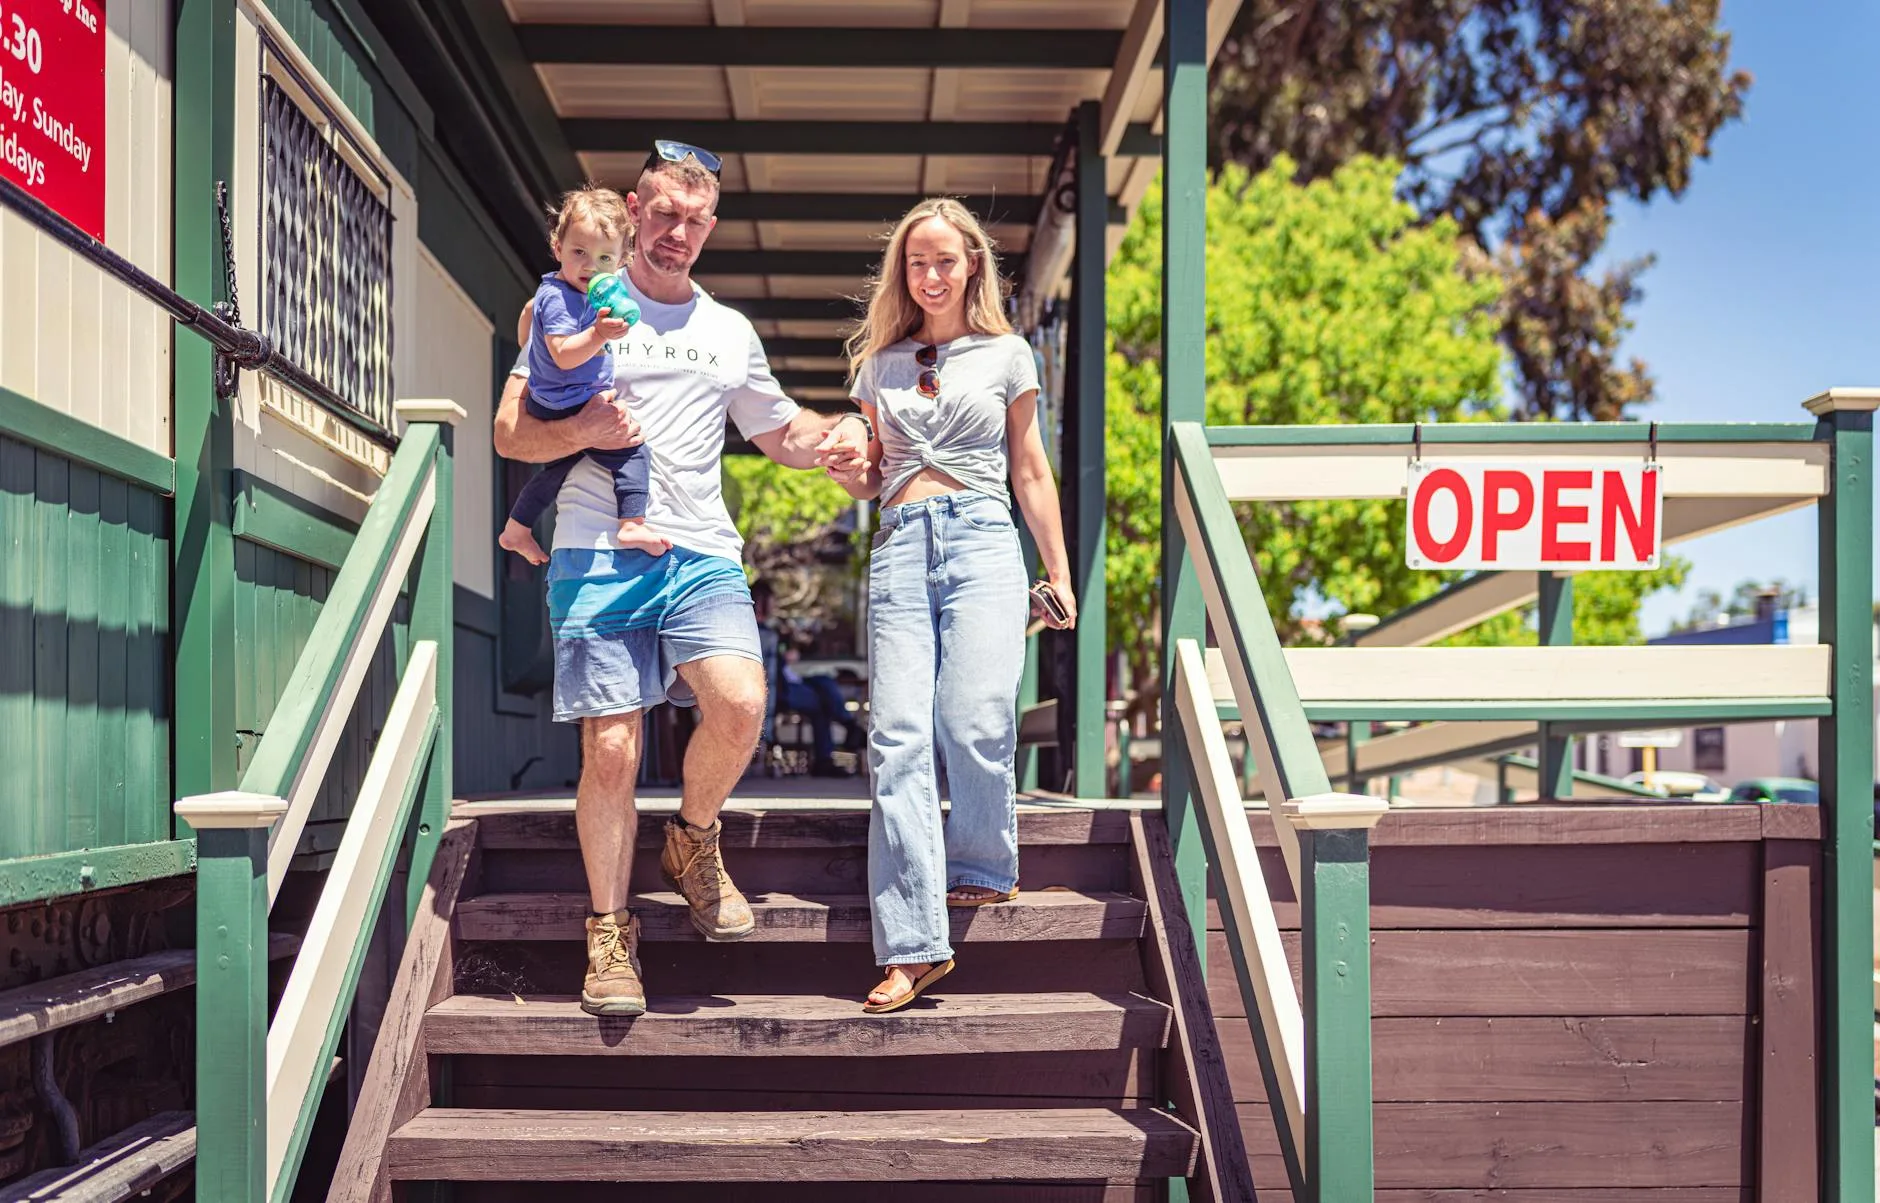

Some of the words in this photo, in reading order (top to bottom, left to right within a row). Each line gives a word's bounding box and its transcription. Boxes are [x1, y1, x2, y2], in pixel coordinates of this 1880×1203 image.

[0, 3, 42, 74] .30
[75, 0, 97, 34] Inc
[0, 65, 27, 123] ay,
[33, 97, 91, 172] Sunday
[618, 343, 720, 368] HYROX
[1413, 468, 1657, 563] OPEN
